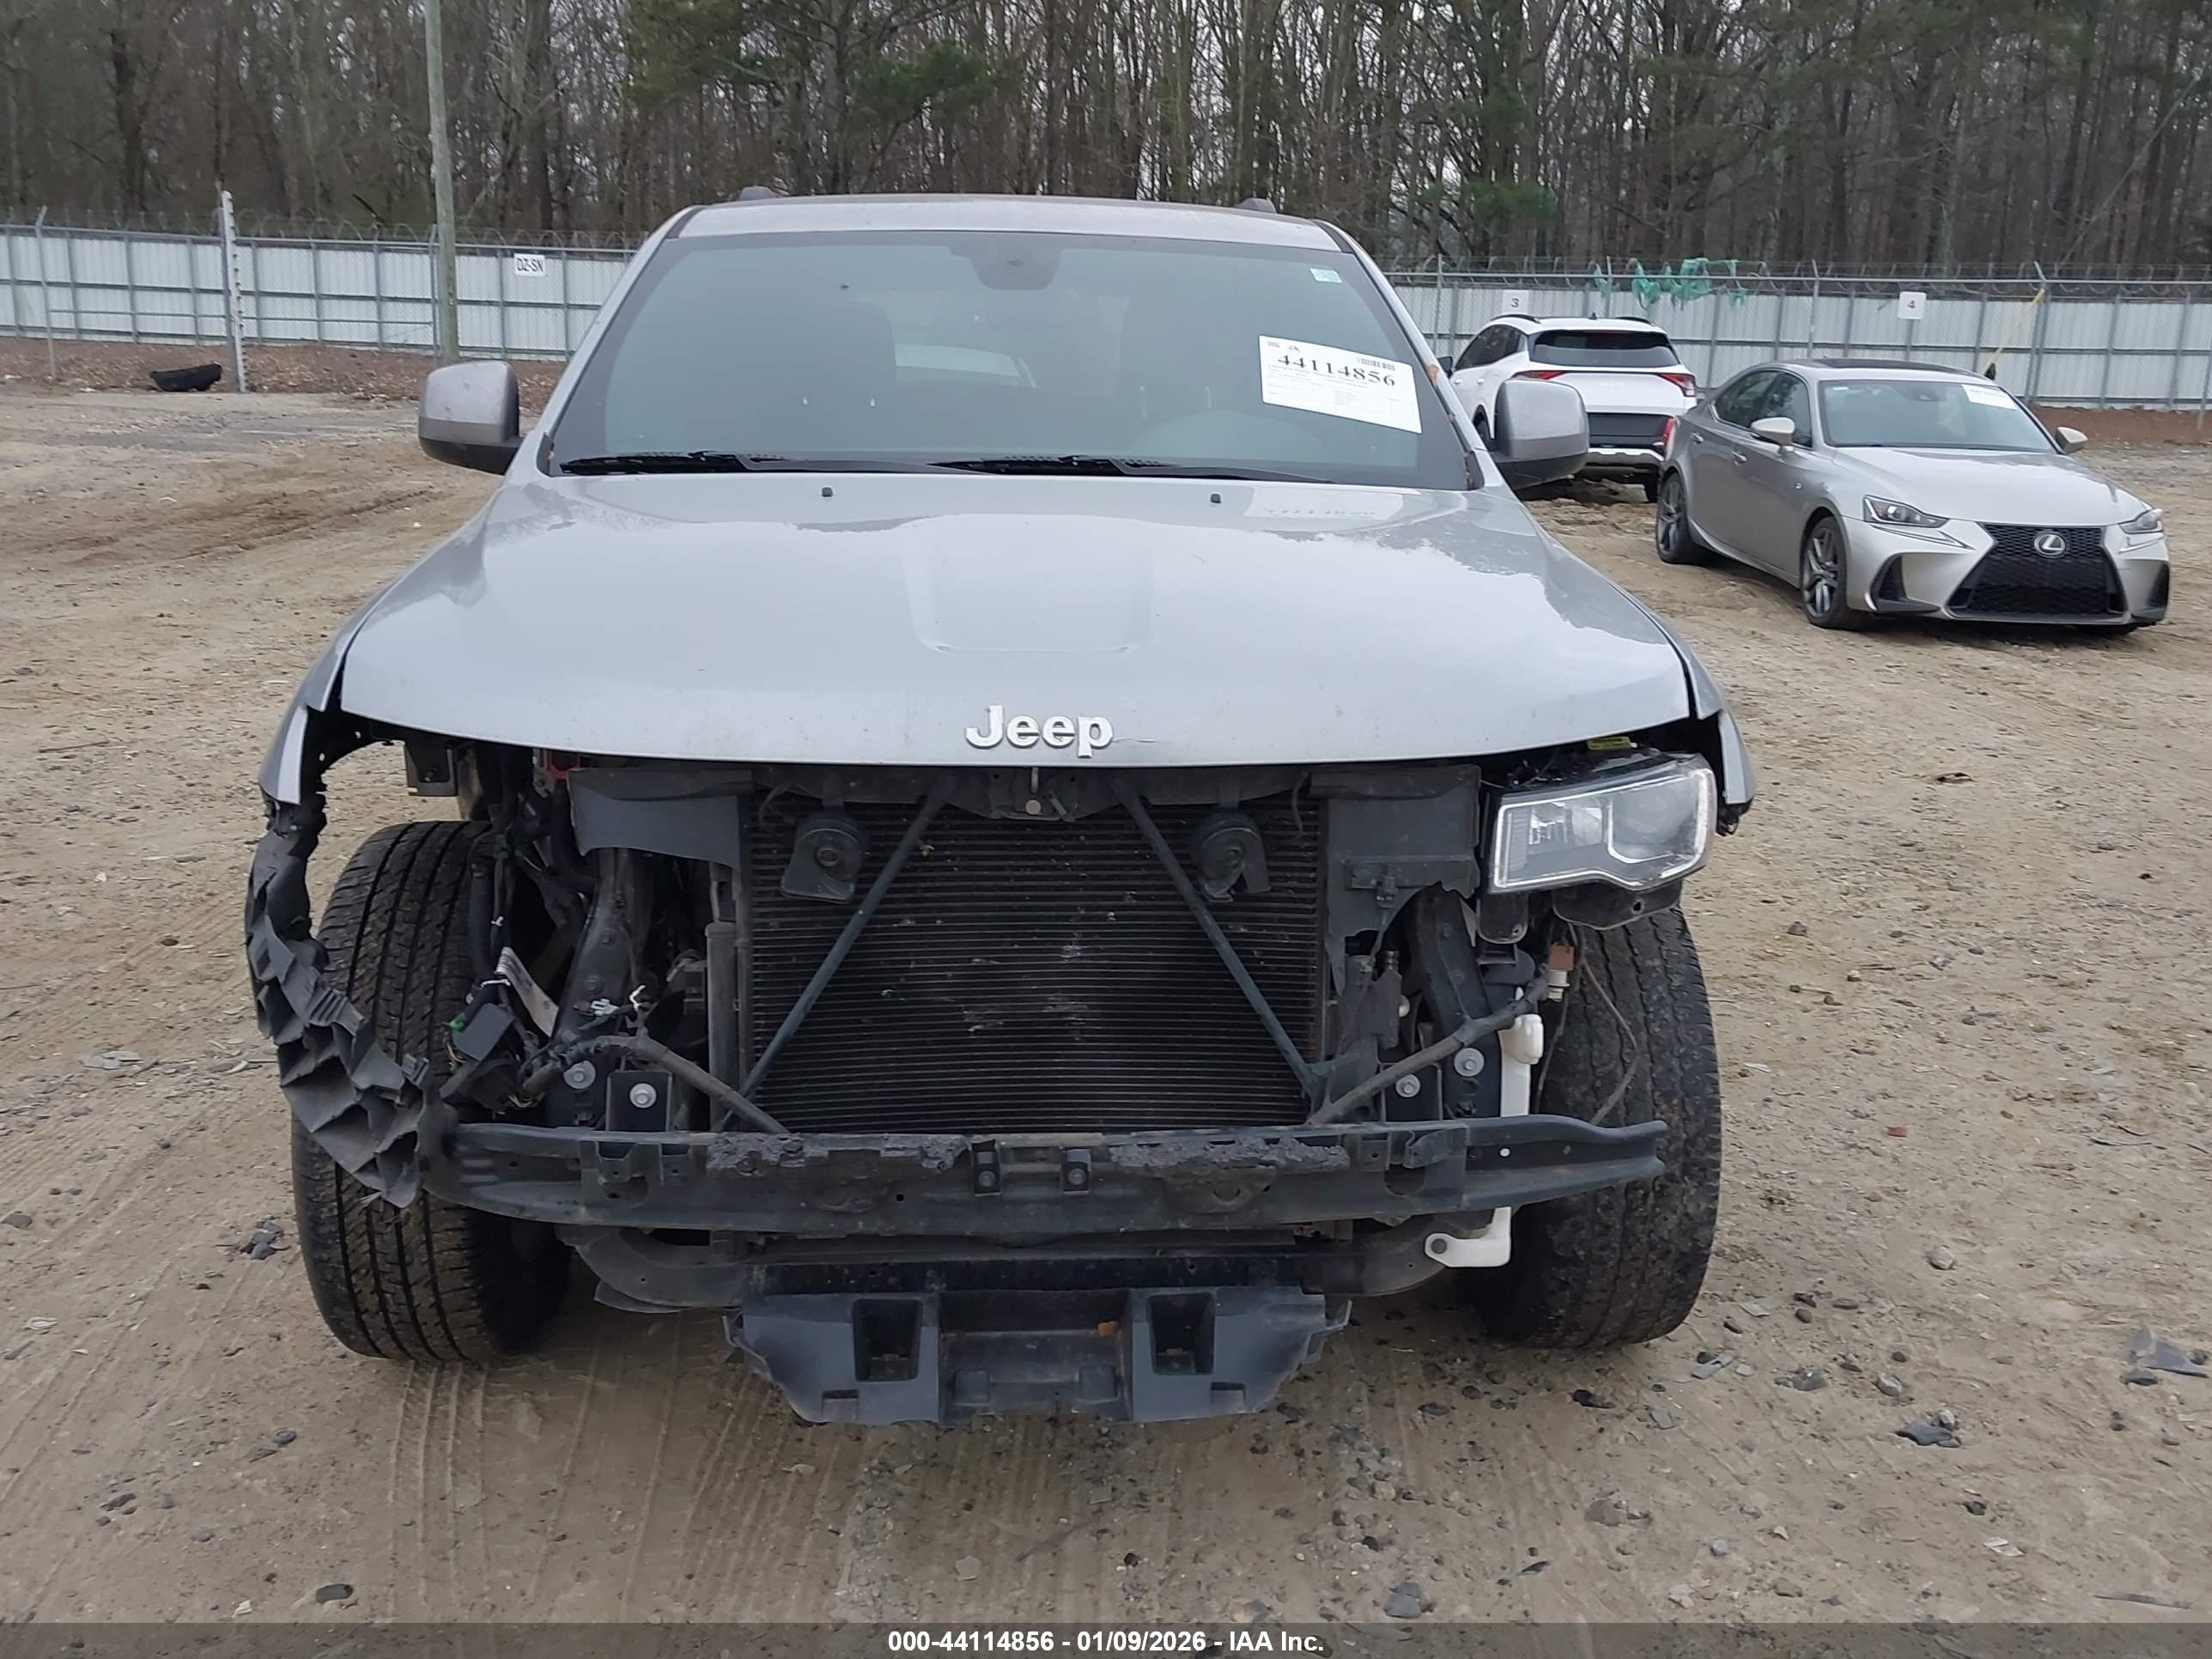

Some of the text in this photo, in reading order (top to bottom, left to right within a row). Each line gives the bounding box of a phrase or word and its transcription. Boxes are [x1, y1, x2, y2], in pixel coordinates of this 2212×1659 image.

[517, 258, 543, 272] DZ-SN
[1510, 298, 1519, 308] 3
[1277, 355, 1396, 386] 44114856
[964, 704, 1114, 758] Jeep
